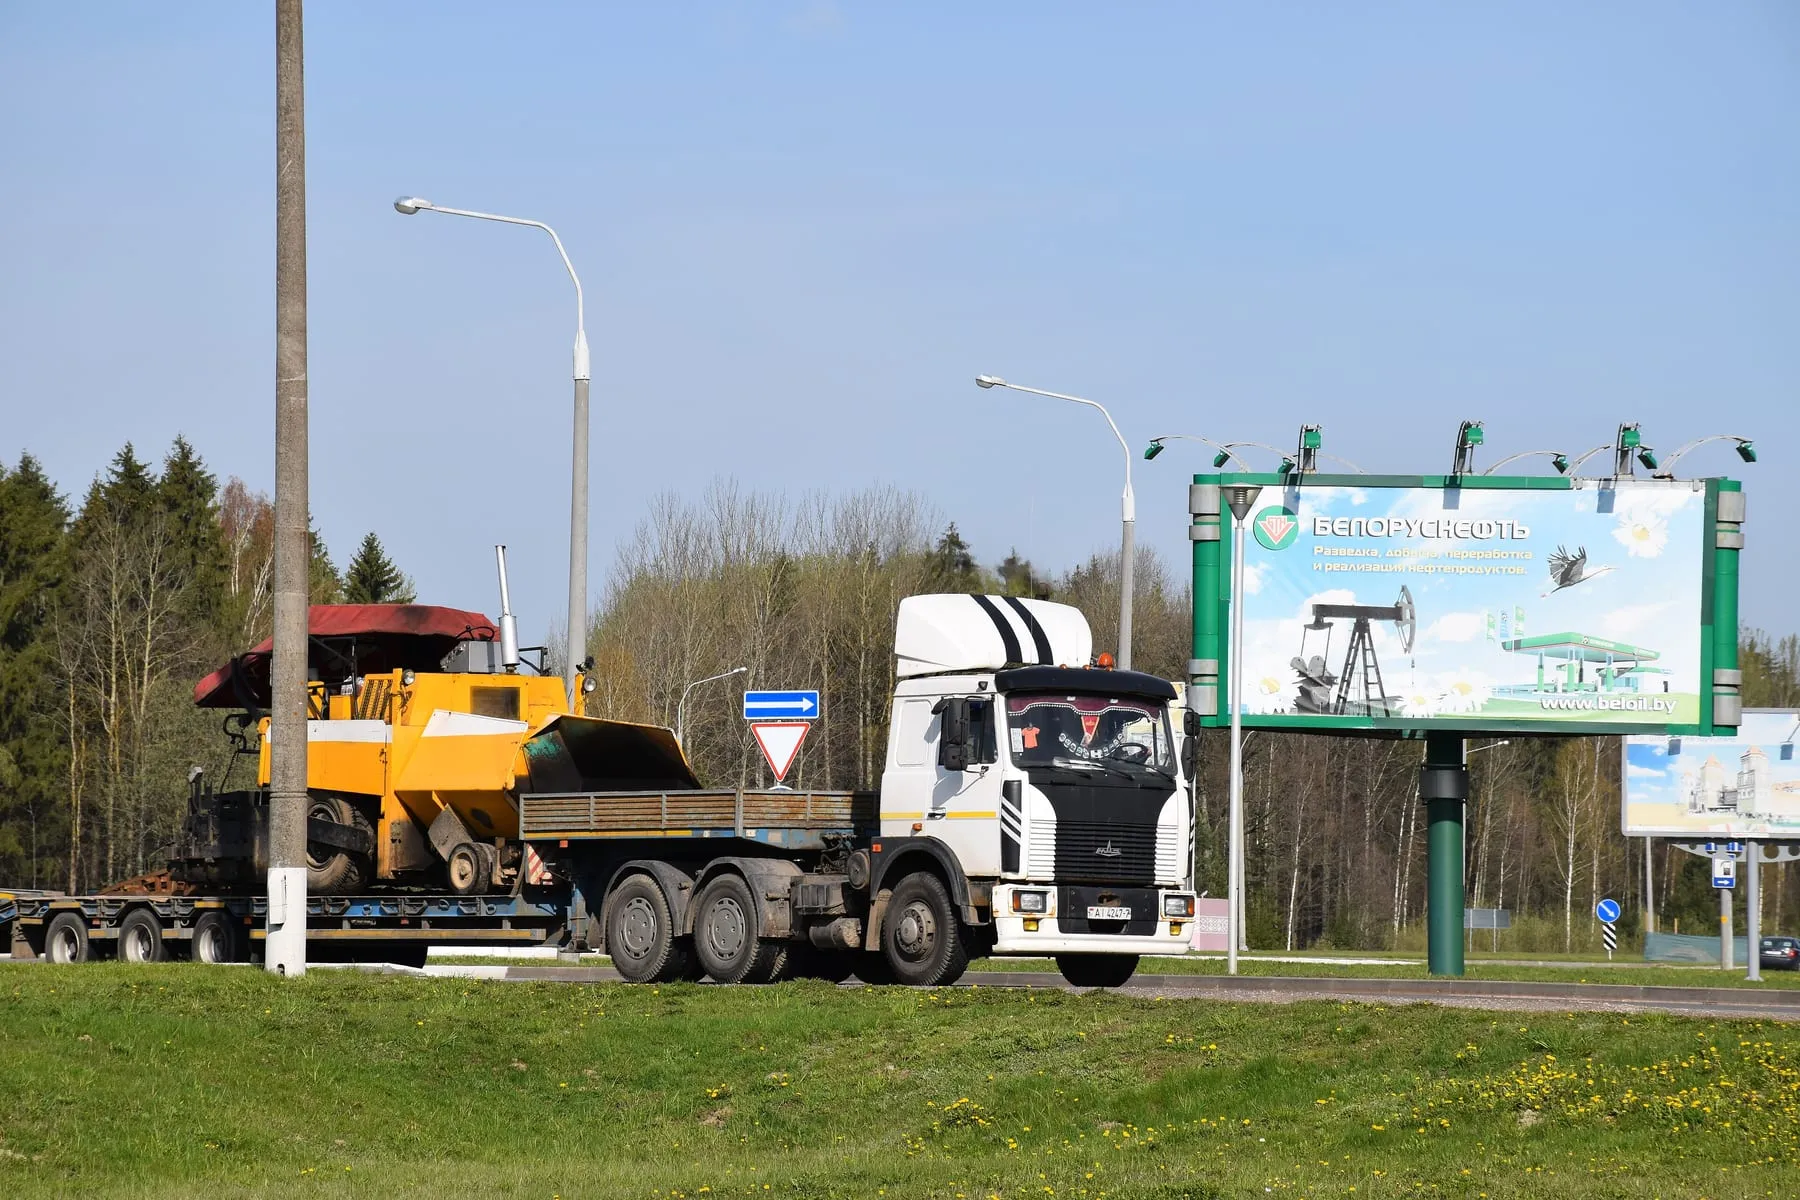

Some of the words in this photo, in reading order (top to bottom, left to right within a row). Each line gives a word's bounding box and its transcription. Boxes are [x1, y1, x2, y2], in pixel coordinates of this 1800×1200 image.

[1313, 516, 1530, 540] БЕЛОРУСНЕФТЬ
[1313, 545, 1382, 558] Разведка,
[1446, 548, 1533, 561] переработка
[1313, 562, 1322, 571] и
[1325, 562, 1405, 573] реализация
[1408, 563, 1528, 575] нефтепродуктов.
[1541, 697, 1676, 713] www.beloil.by
